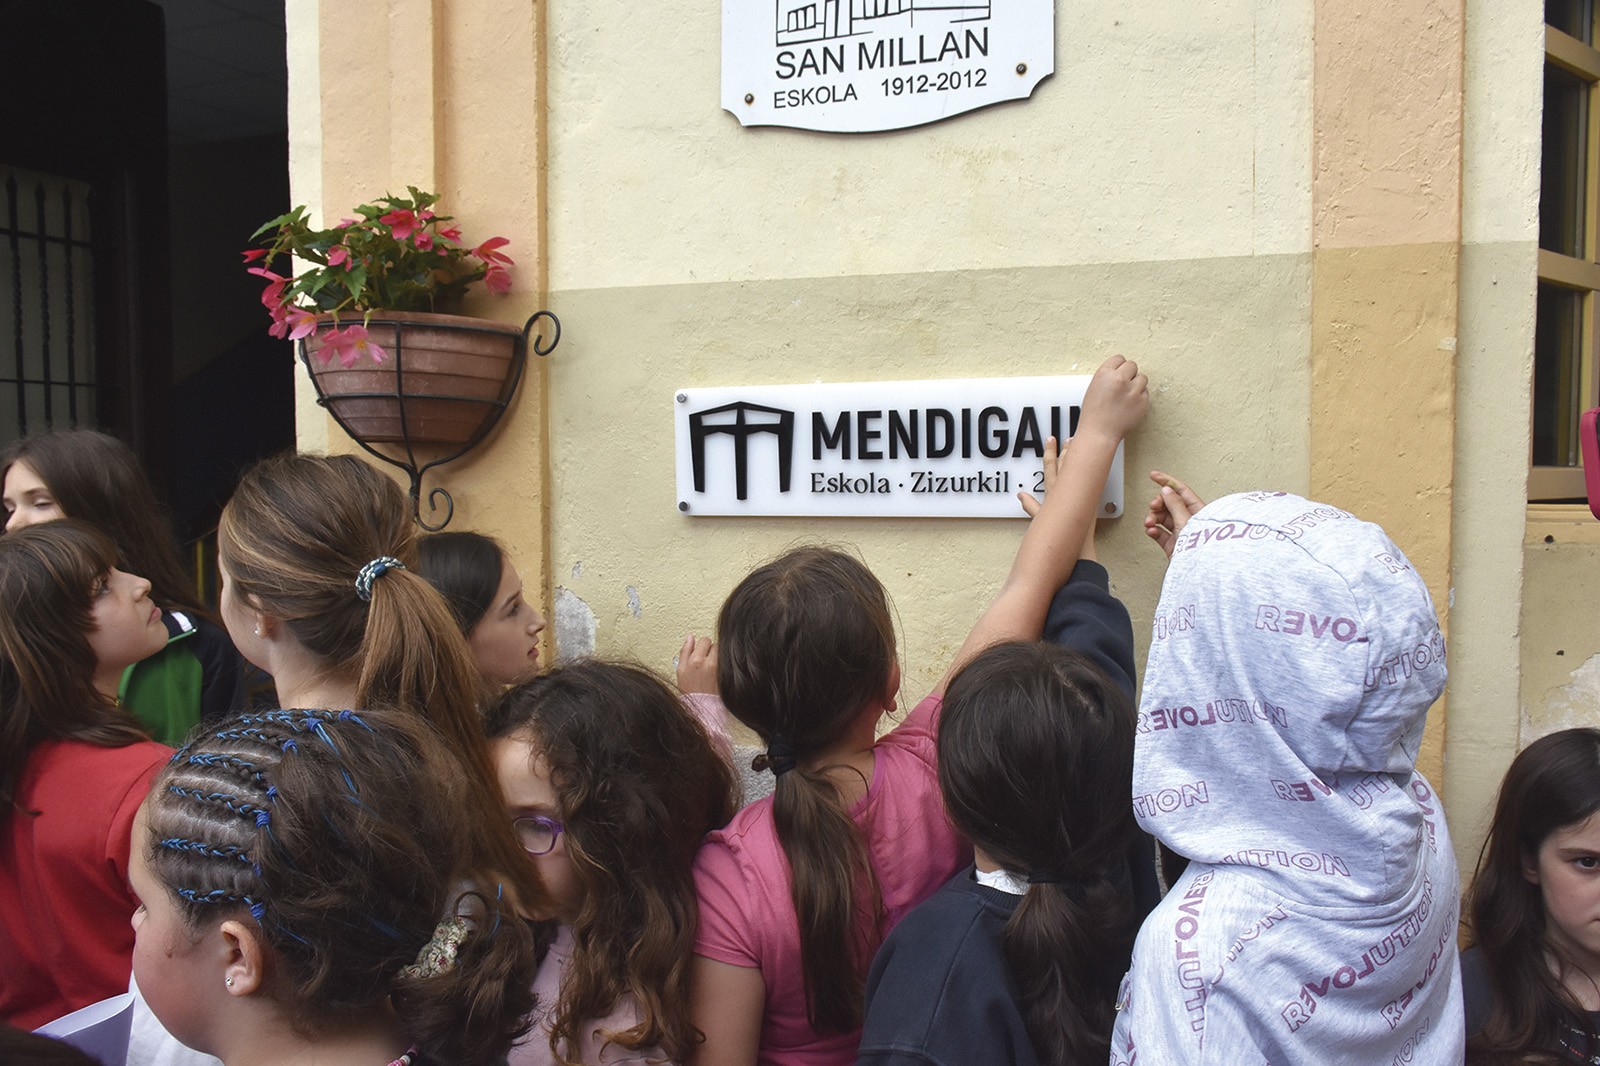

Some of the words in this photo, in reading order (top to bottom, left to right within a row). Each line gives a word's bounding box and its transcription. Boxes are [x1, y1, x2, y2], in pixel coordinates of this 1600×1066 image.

[776, 46, 844, 80] SAN
[858, 27, 988, 71] MILLAN
[774, 83, 858, 108] ESKOLA
[881, 69, 987, 97] 1912-2012
[810, 472, 891, 494] Eskola
[910, 470, 1009, 493] Zizurkil
